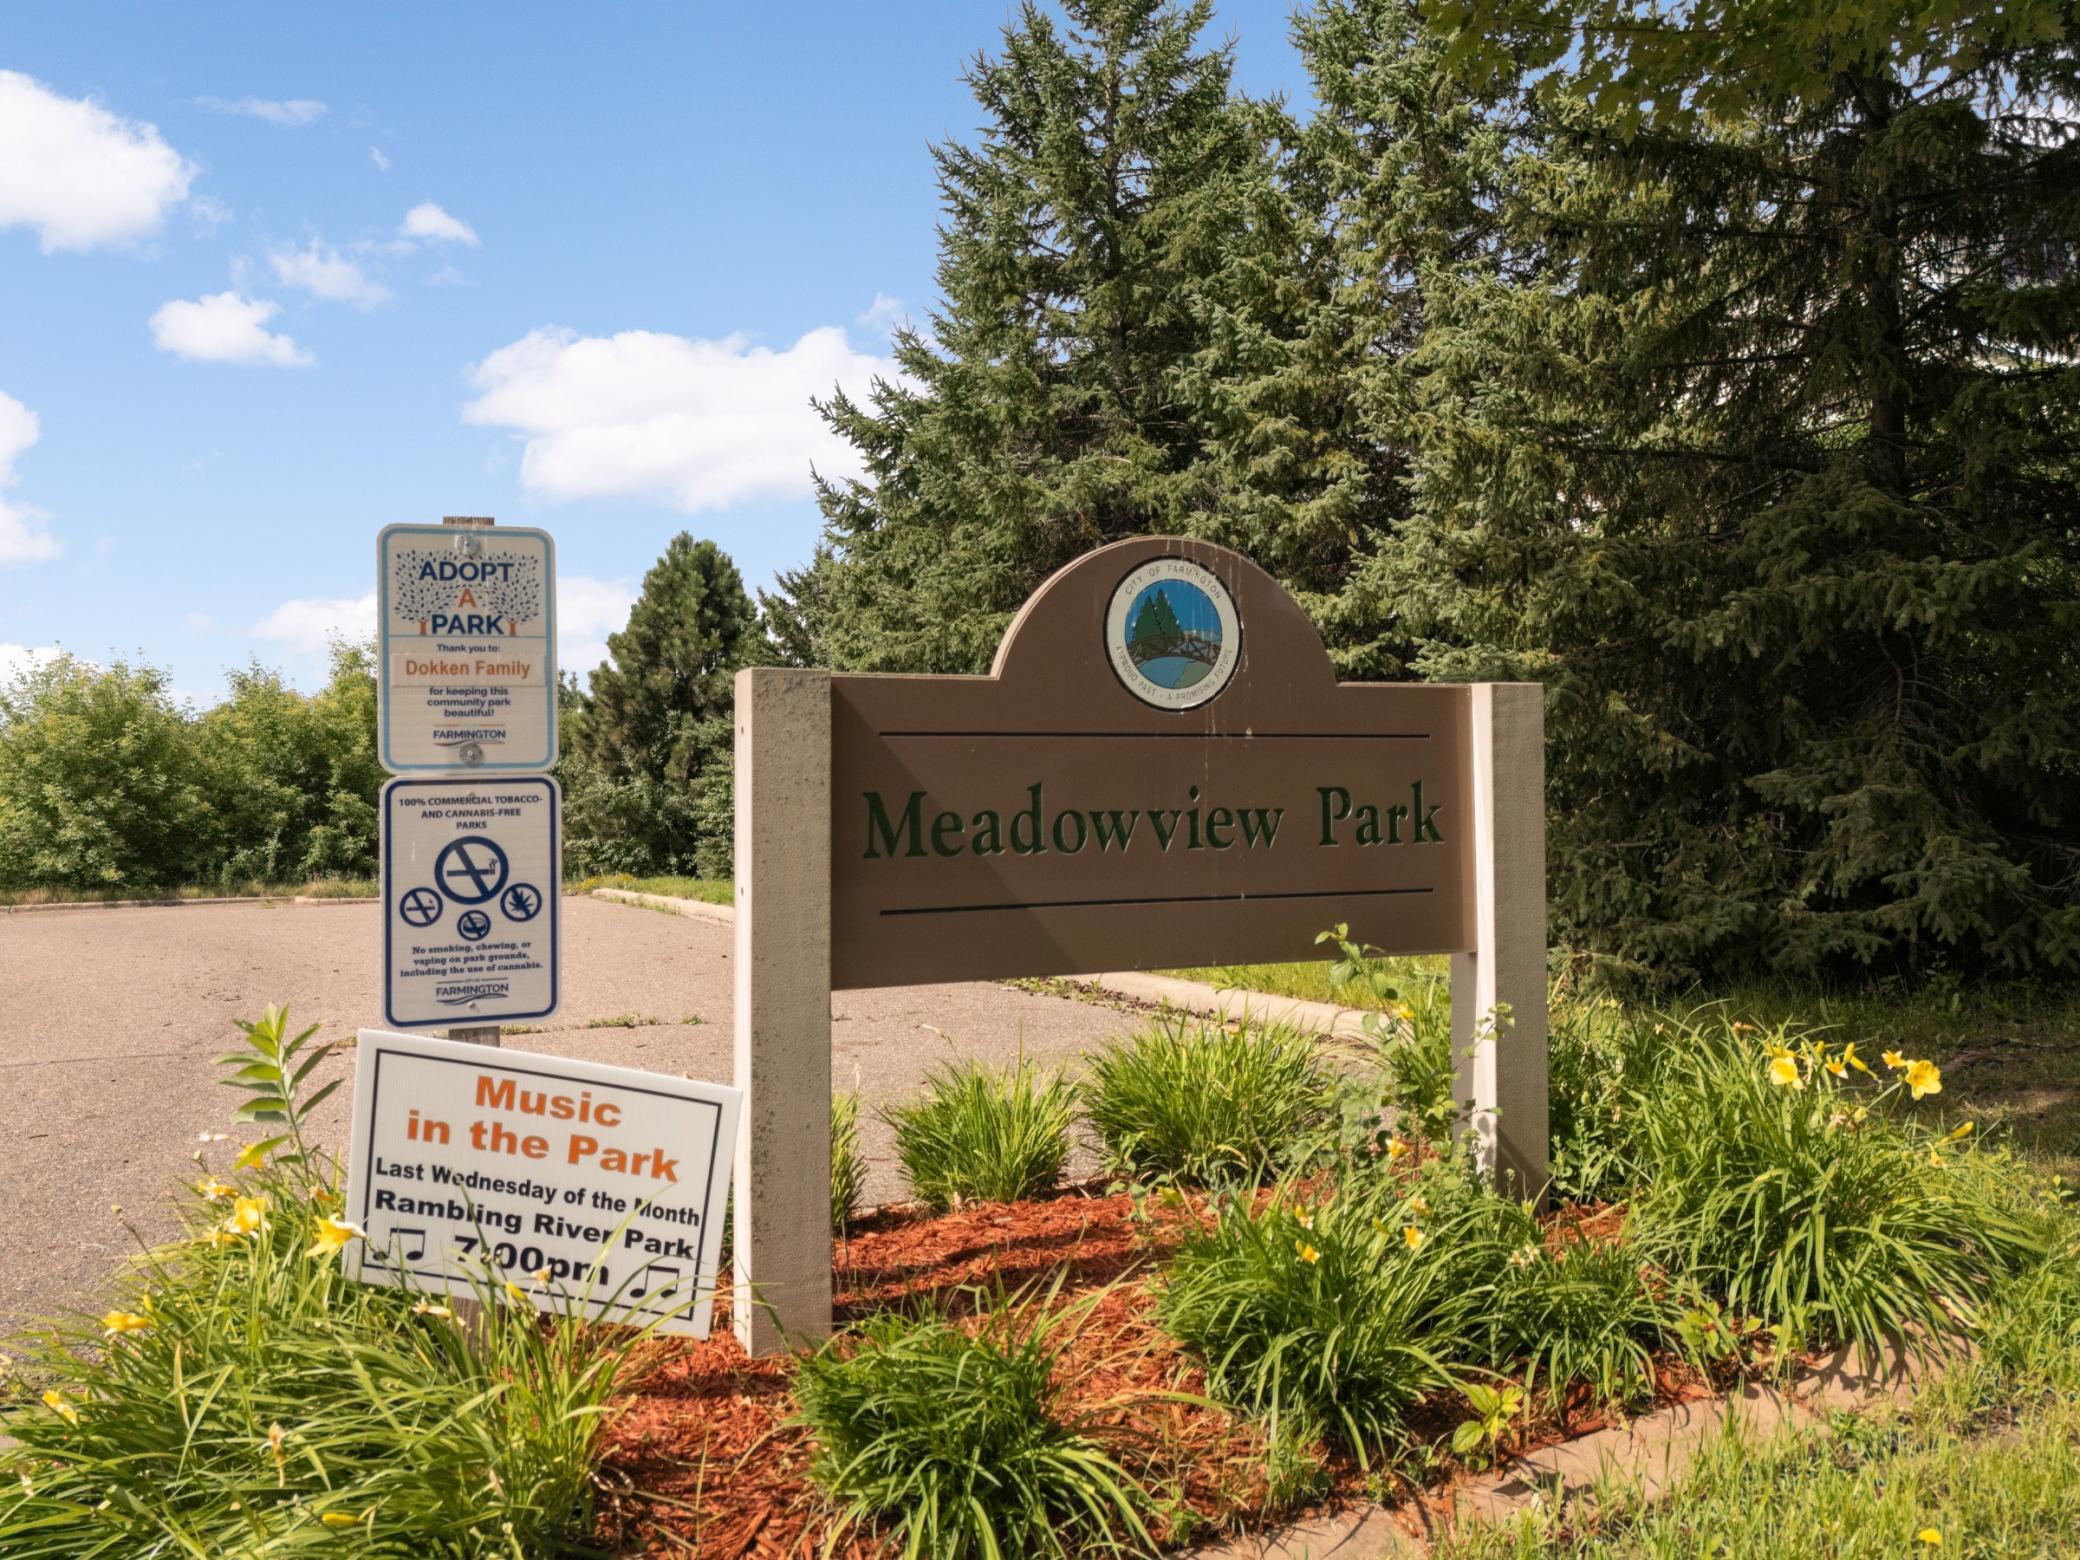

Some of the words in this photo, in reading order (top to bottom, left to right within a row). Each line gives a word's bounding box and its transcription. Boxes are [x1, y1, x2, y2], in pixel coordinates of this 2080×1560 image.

[418, 561, 514, 582] ADOPT
[1125, 575, 1143, 595] CITY
[1148, 566, 1160, 577] OF
[1167, 564, 1222, 599] FARMINGTON
[458, 588, 477, 608] A
[431, 614, 505, 634] PARK
[437, 643, 467, 653] Thank
[468, 645, 486, 654] you
[488, 644, 500, 653] to:
[405, 659, 470, 676] Dokken
[475, 659, 531, 679] Family
[429, 686, 444, 695] for
[446, 686, 488, 697] keeping
[490, 686, 509, 695] this
[427, 698, 486, 707] community
[488, 698, 511, 707] park
[444, 708, 495, 718] beautiful!
[432, 729, 506, 739] FARMINGTON
[399, 797, 426, 807] 100%
[428, 796, 492, 806] COMMERCIAL
[495, 795, 543, 804] TOBACCO-
[421, 809, 443, 819] AND
[445, 808, 521, 818] CANNABIS-FREE
[862, 781, 1285, 859] Meadowview
[1316, 780, 1447, 847] Park
[456, 821, 487, 830] PARKS
[412, 946, 426, 955] No
[428, 944, 474, 954] smoking,
[476, 942, 519, 951] chewing,
[413, 957, 446, 967] vaping
[463, 954, 486, 964] park
[488, 952, 530, 962] grounds,
[400, 967, 447, 978] including
[449, 966, 465, 974] the
[467, 965, 484, 973] use
[486, 964, 496, 972] of
[497, 961, 543, 971] cannabis.
[436, 983, 509, 997] FARMINGTON
[475, 1075, 622, 1128] Music
[406, 1110, 451, 1145] in
[470, 1120, 550, 1160] the
[568, 1135, 680, 1183] Park
[375, 1157, 425, 1181] Last
[432, 1165, 557, 1204] Wednesday
[563, 1188, 587, 1206] of
[592, 1192, 627, 1212] the
[634, 1197, 700, 1227] Month
[375, 1189, 522, 1235] Rambling
[624, 1228, 695, 1260] Park
